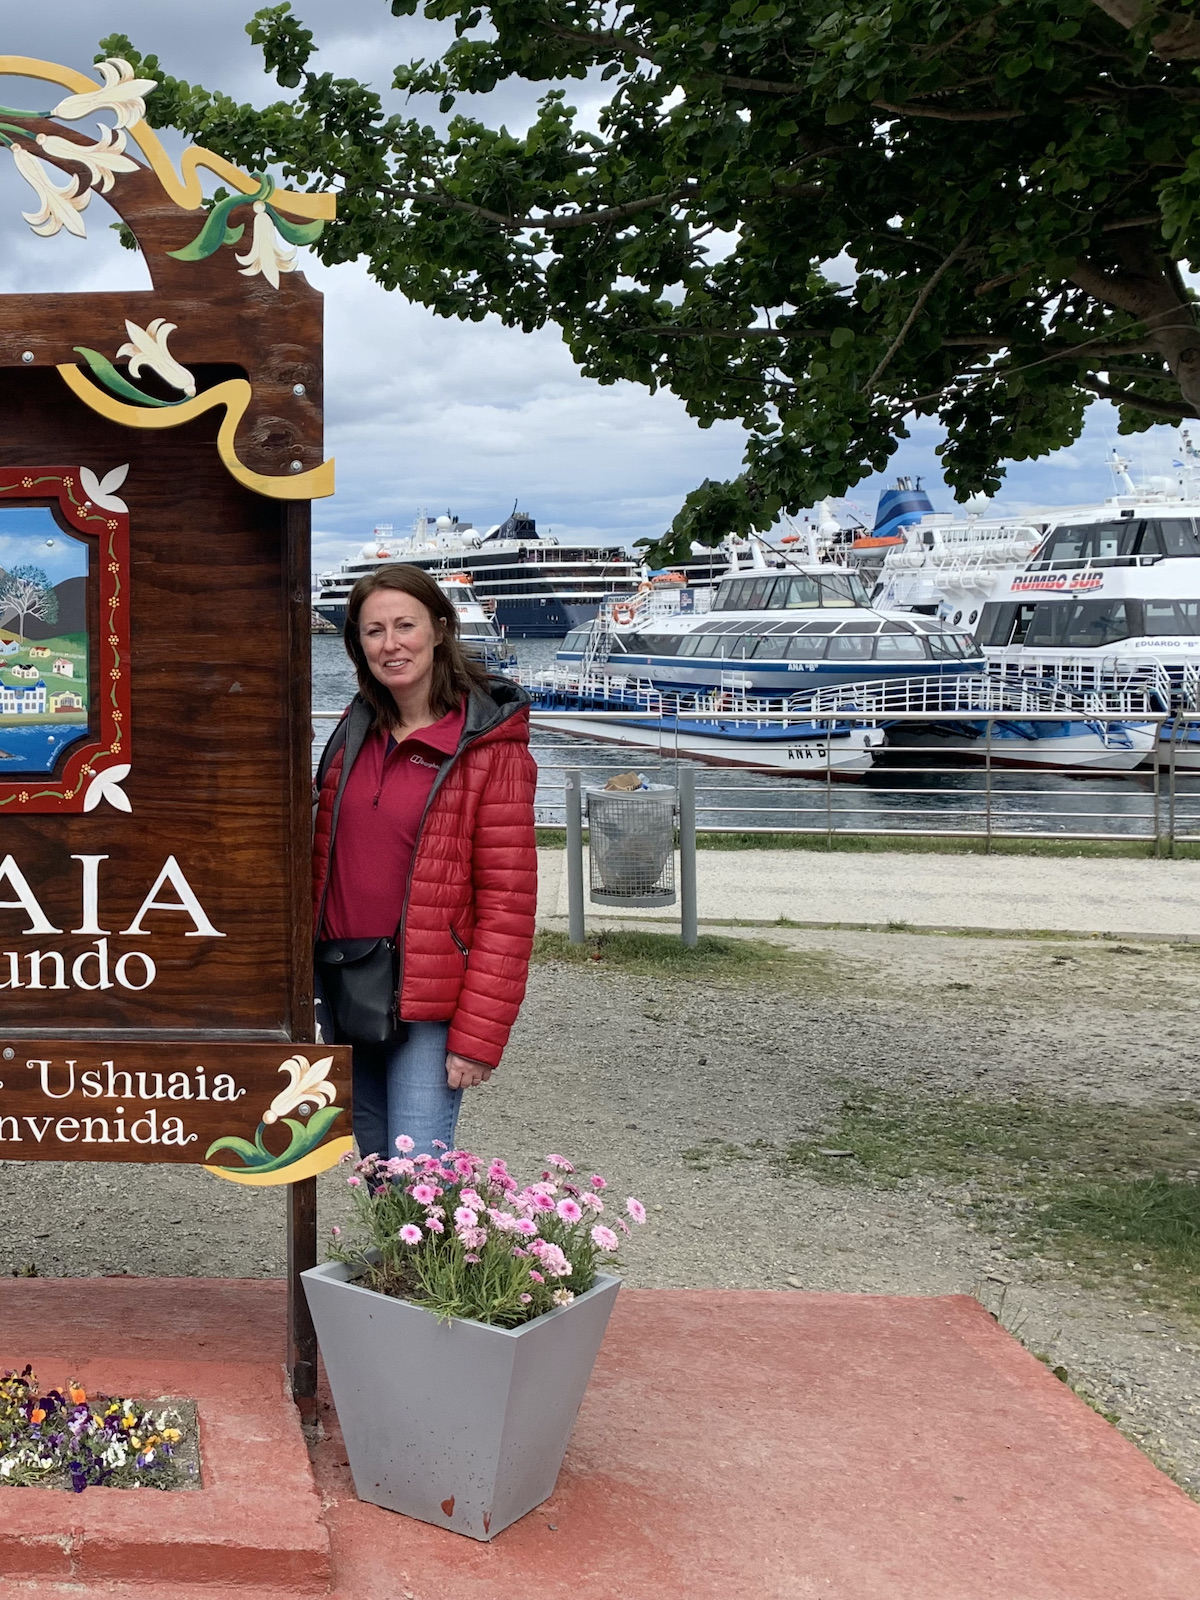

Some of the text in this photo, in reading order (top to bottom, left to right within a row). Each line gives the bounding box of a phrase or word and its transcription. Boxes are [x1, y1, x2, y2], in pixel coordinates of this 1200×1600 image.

[1010, 574, 1067, 591] RUMBO
[1069, 572, 1104, 588] SUR
[1135, 640, 1181, 648] EDUARDO
[787, 663, 805, 671] ANA
[788, 744, 813, 760] ANA
[25, 1059, 247, 1102] Ushuaia
